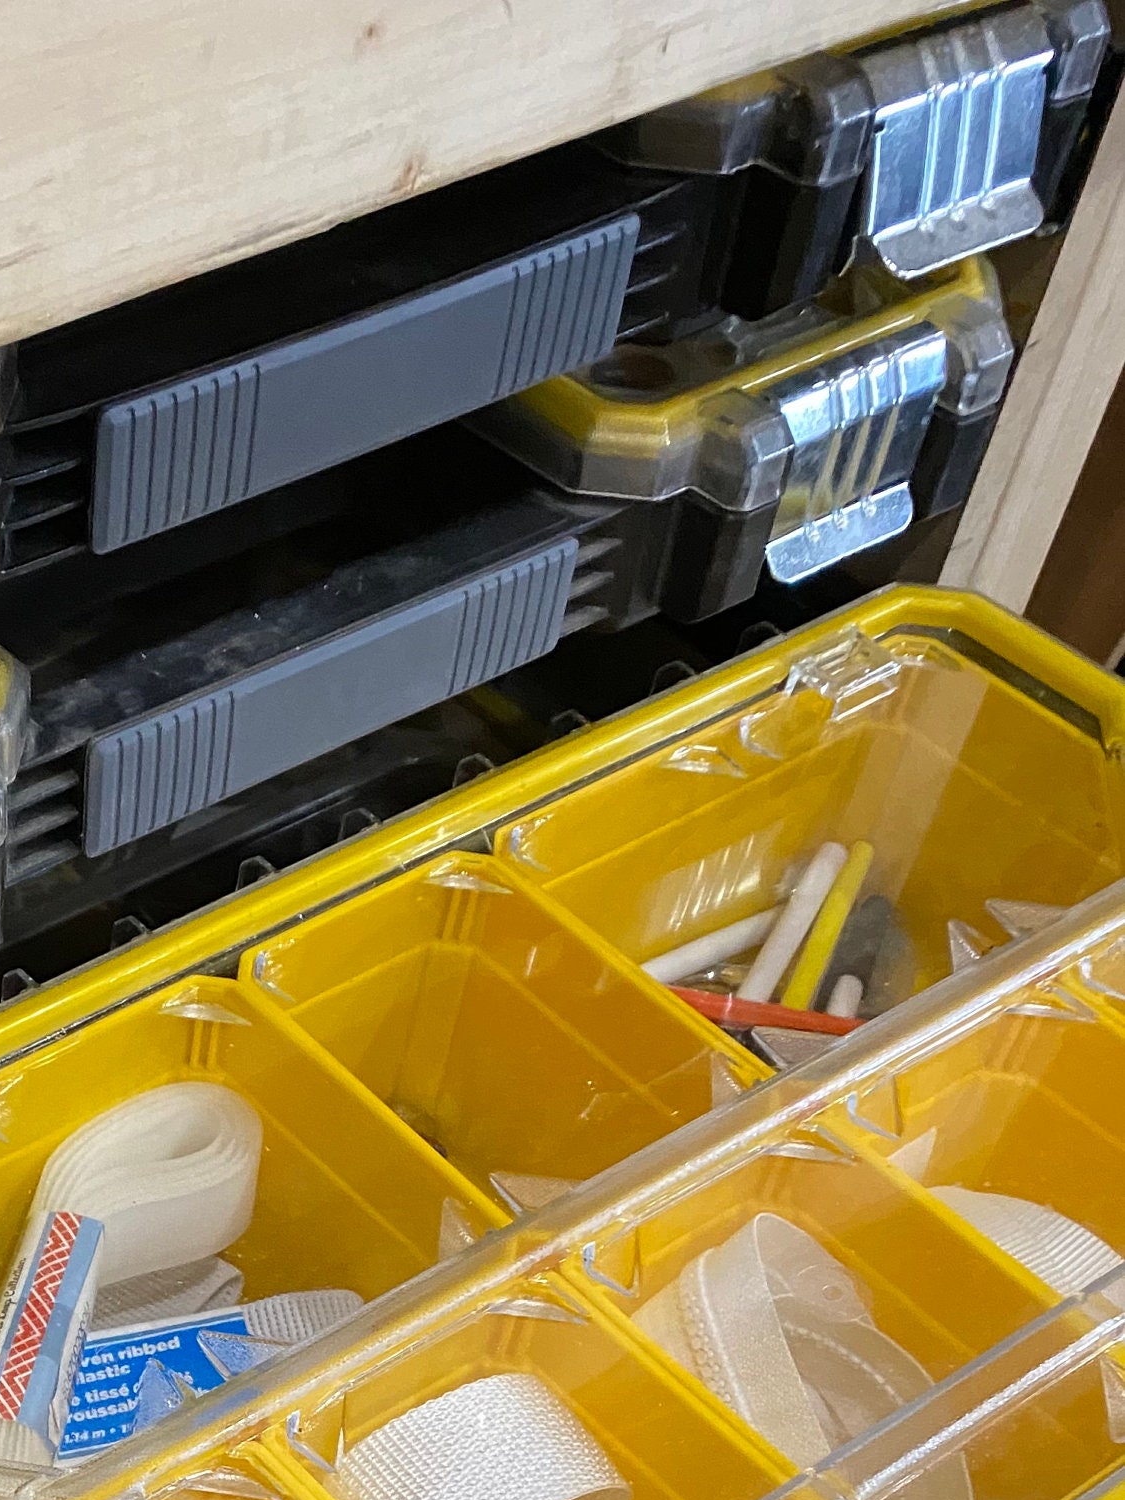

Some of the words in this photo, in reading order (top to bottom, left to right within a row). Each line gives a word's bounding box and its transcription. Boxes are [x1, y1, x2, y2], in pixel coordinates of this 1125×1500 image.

[79, 1352, 114, 1368] ven
[117, 1336, 181, 1360] ribbed
[76, 1363, 131, 1385] lastic
[84, 1383, 130, 1405] tissé
[92, 1429, 106, 1439] m
